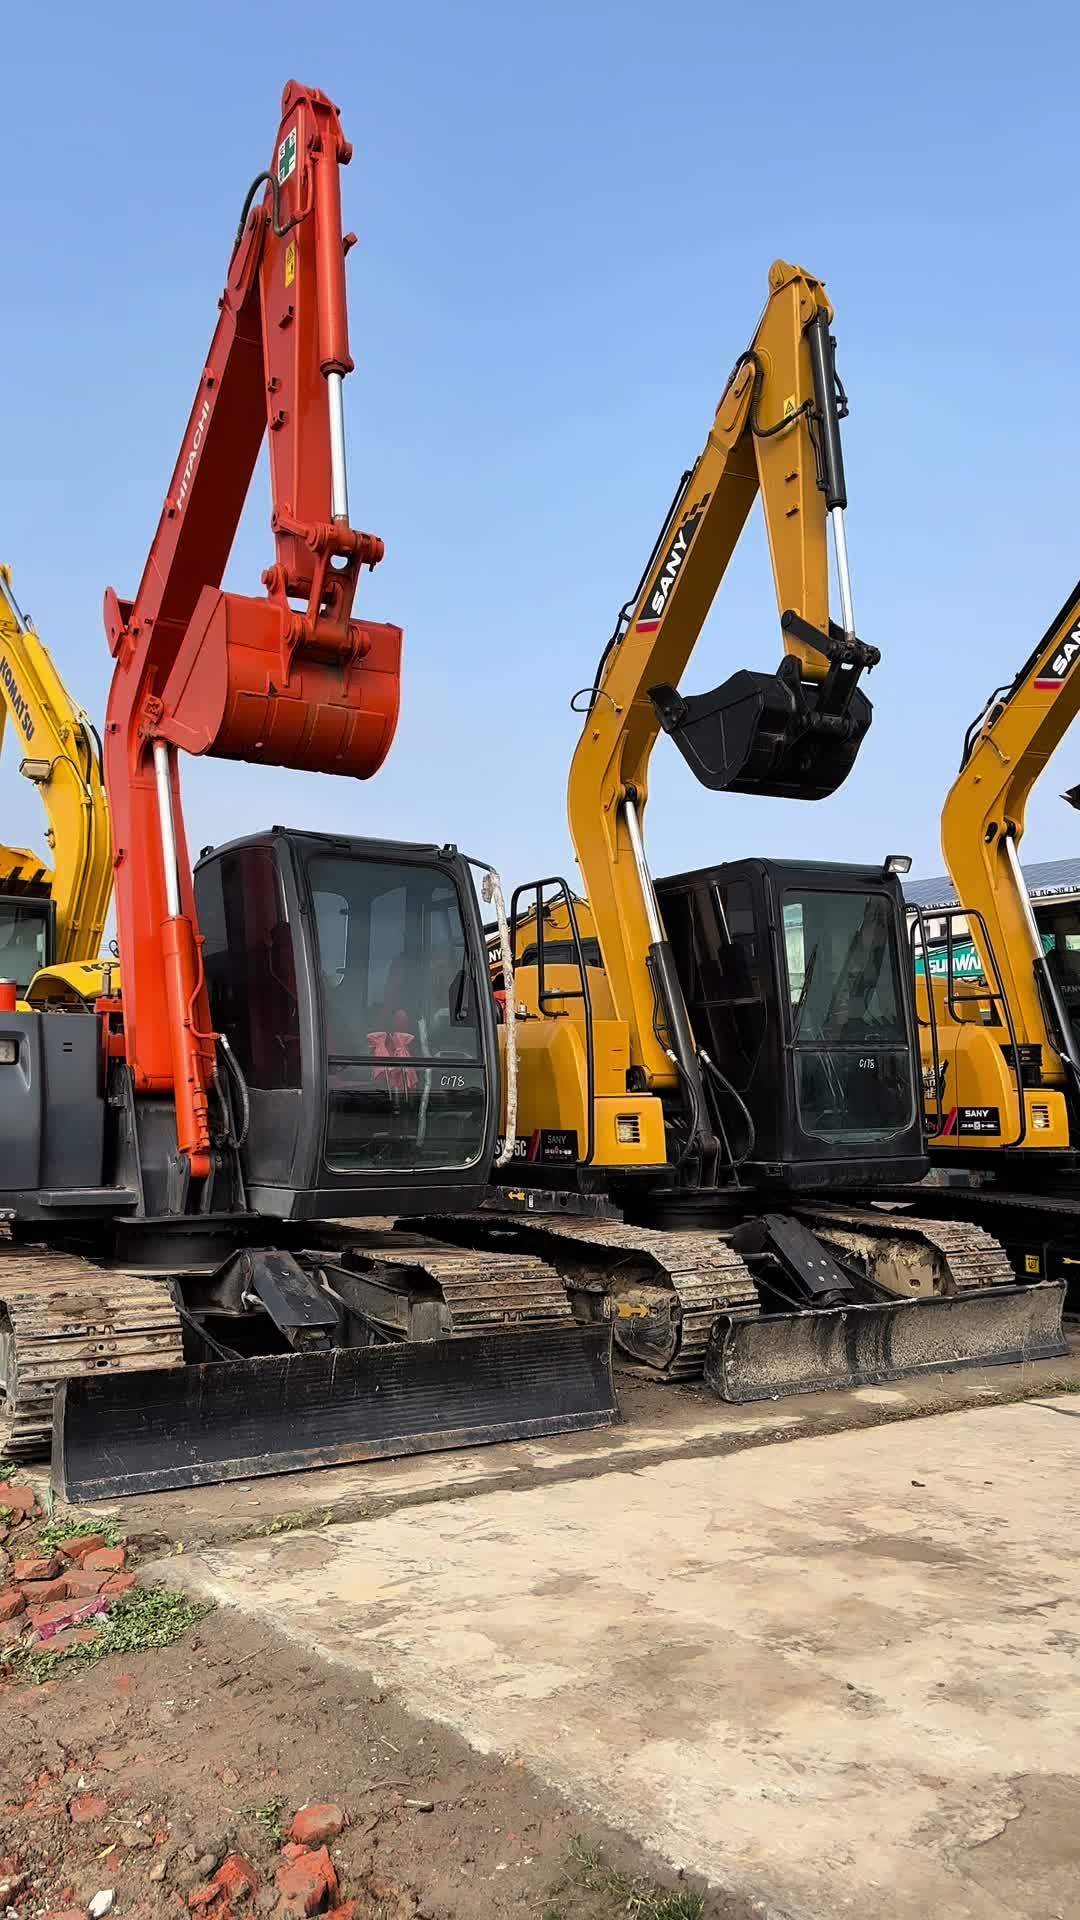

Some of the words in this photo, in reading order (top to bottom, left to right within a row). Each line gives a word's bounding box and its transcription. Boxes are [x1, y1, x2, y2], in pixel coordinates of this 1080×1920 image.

[177, 400, 210, 511] HITACHI
[652, 530, 687, 615] SANY
[0, 656, 35, 741] KOMATSU
[489, 949, 502, 963] NY
[928, 947, 982, 973] SUNWA
[547, 1135, 567, 1145] SANY
